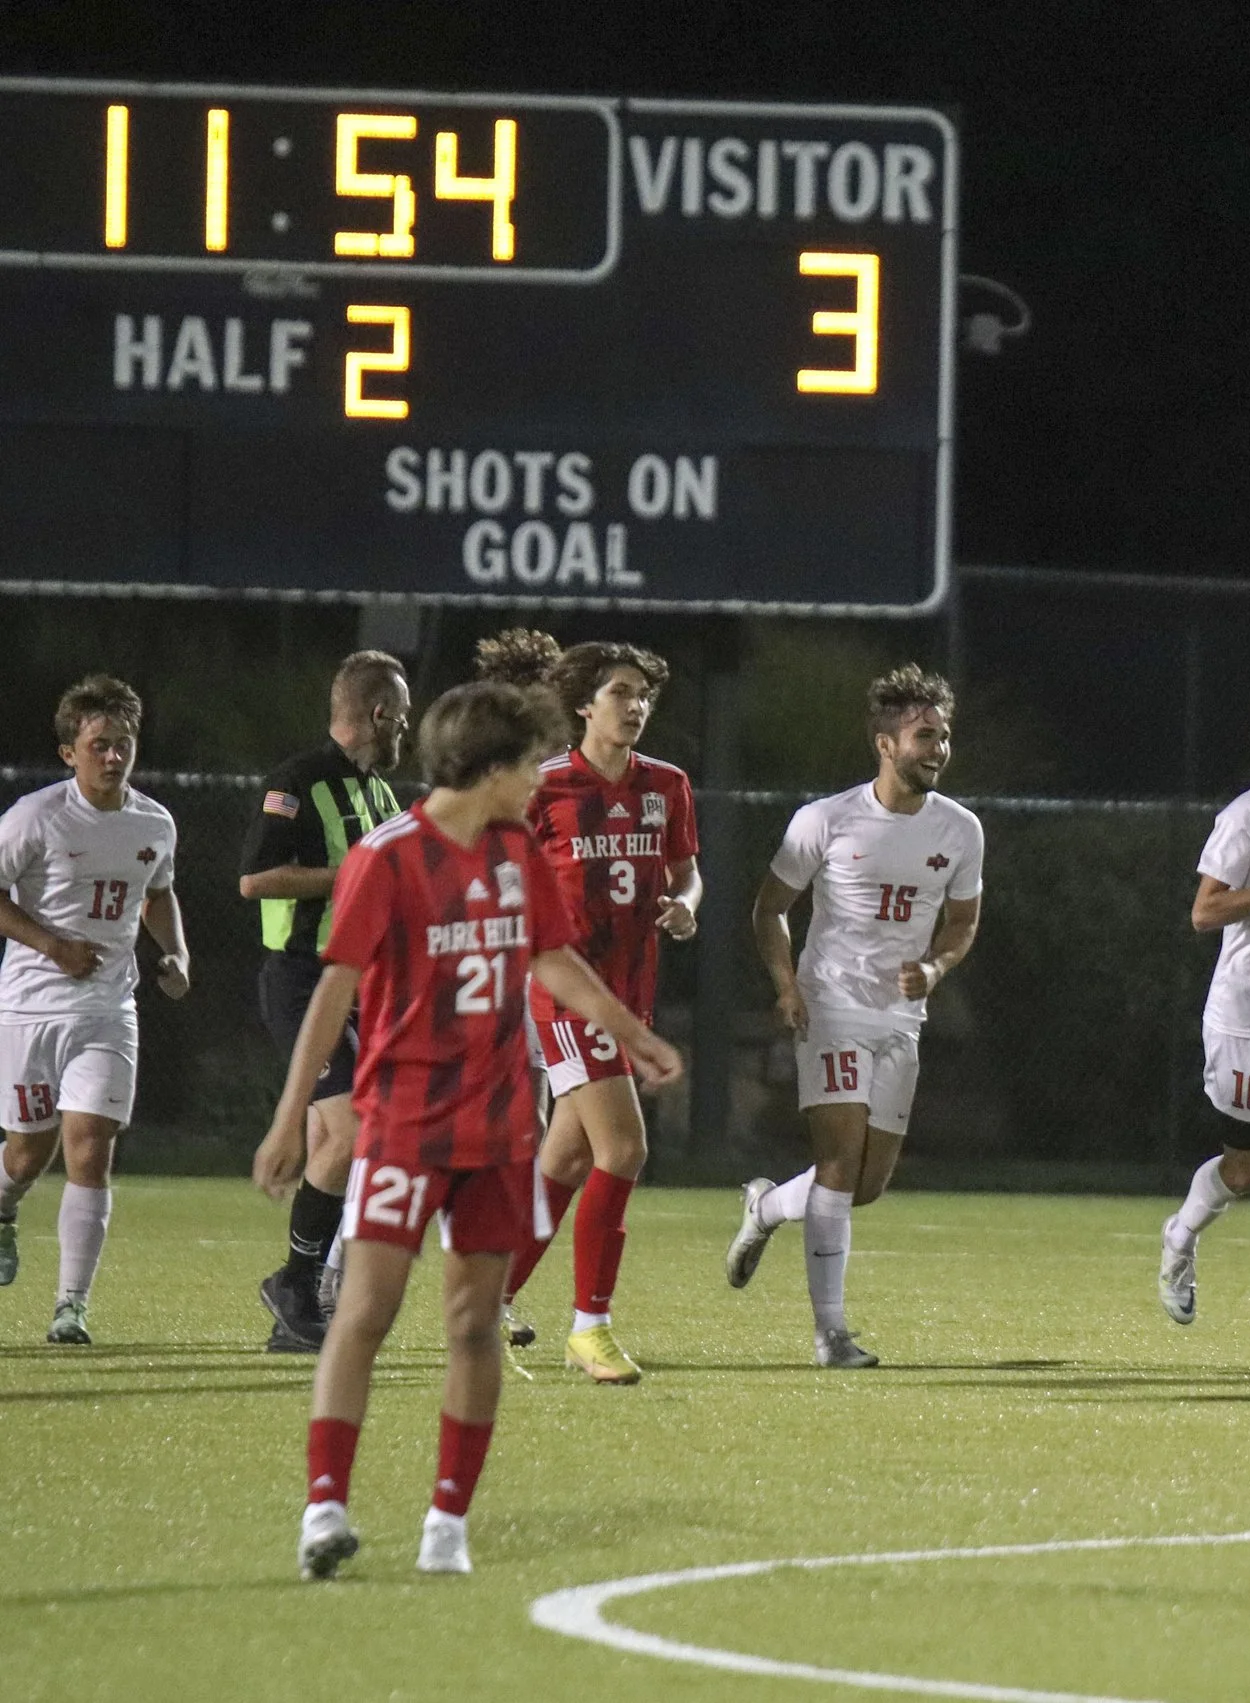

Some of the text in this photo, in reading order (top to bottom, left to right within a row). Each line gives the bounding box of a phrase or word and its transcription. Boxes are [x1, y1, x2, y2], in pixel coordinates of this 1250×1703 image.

[105, 105, 518, 260] 11:54
[628, 135, 935, 223] VISITOR
[796, 250, 880, 395] 3
[113, 313, 313, 394] HALF
[344, 304, 411, 420] 2
[385, 446, 718, 520] SHOTS ON
[461, 519, 645, 588] GOAL
[571, 834, 622, 860] PARK
[87, 879, 129, 921] 13
[609, 860, 636, 905] 3
[874, 883, 918, 923] 15
[426, 915, 528, 957] PARK HILL
[455, 952, 507, 1015] 21
[584, 1020, 618, 1063] 3
[820, 1050, 859, 1092] 15
[13, 1083, 54, 1123] 13
[363, 1166, 428, 1227] 21
